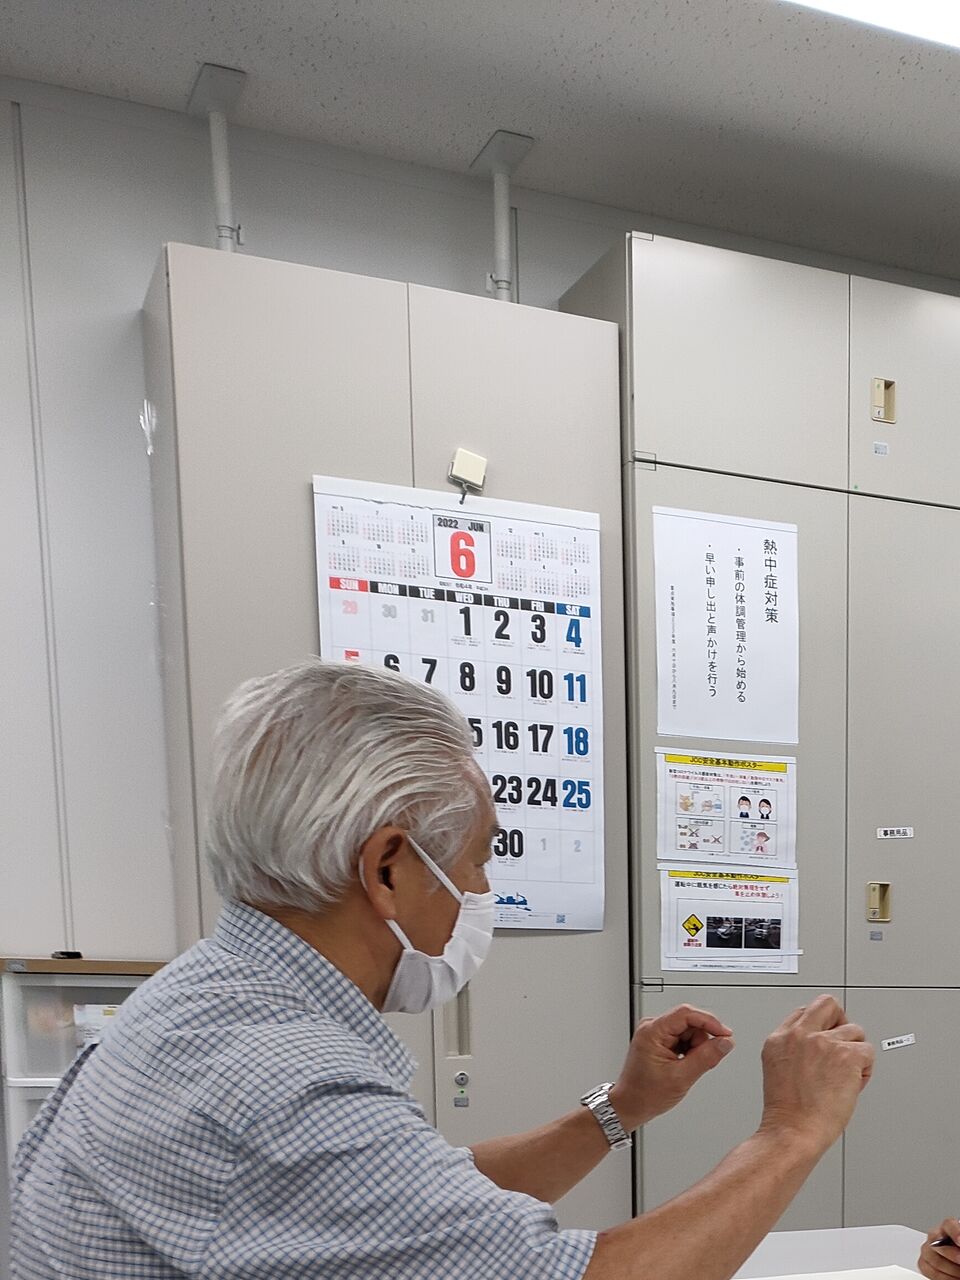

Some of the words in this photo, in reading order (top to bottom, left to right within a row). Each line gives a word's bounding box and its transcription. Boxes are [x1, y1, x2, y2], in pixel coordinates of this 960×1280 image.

[437, 517, 459, 529] 2022
[468, 521, 484, 532] JUN
[450, 530, 476, 578] 6
[340, 579, 359, 590] SUN
[378, 582, 399, 595] MON
[419, 587, 436, 599] TUE
[455, 592, 474, 604] WED
[493, 596, 510, 608] THU
[531, 601, 544, 612] FRI
[566, 604, 580, 616] SAT
[763, 539, 778, 623] 熱中症対策
[381, 604, 397, 619] 30
[421, 608, 435, 623] 31
[459, 606, 471, 636] 1
[494, 609, 510, 640] 2
[531, 614, 546, 643] 3
[566, 618, 582, 648] 4
[421, 657, 437, 684] 7
[460, 662, 476, 691] 8
[496, 665, 511, 695] 9
[526, 669, 553, 699] 10
[563, 672, 586, 702] 11
[492, 720, 519, 750] 16
[528, 723, 554, 753] 17
[563, 727, 589, 756] 18
[492, 775, 522, 804] 23
[527, 777, 558, 807] 24
[562, 779, 591, 809] 25
[494, 829, 524, 858] 30
[540, 838, 547, 851] 1
[574, 840, 581, 852] 2
